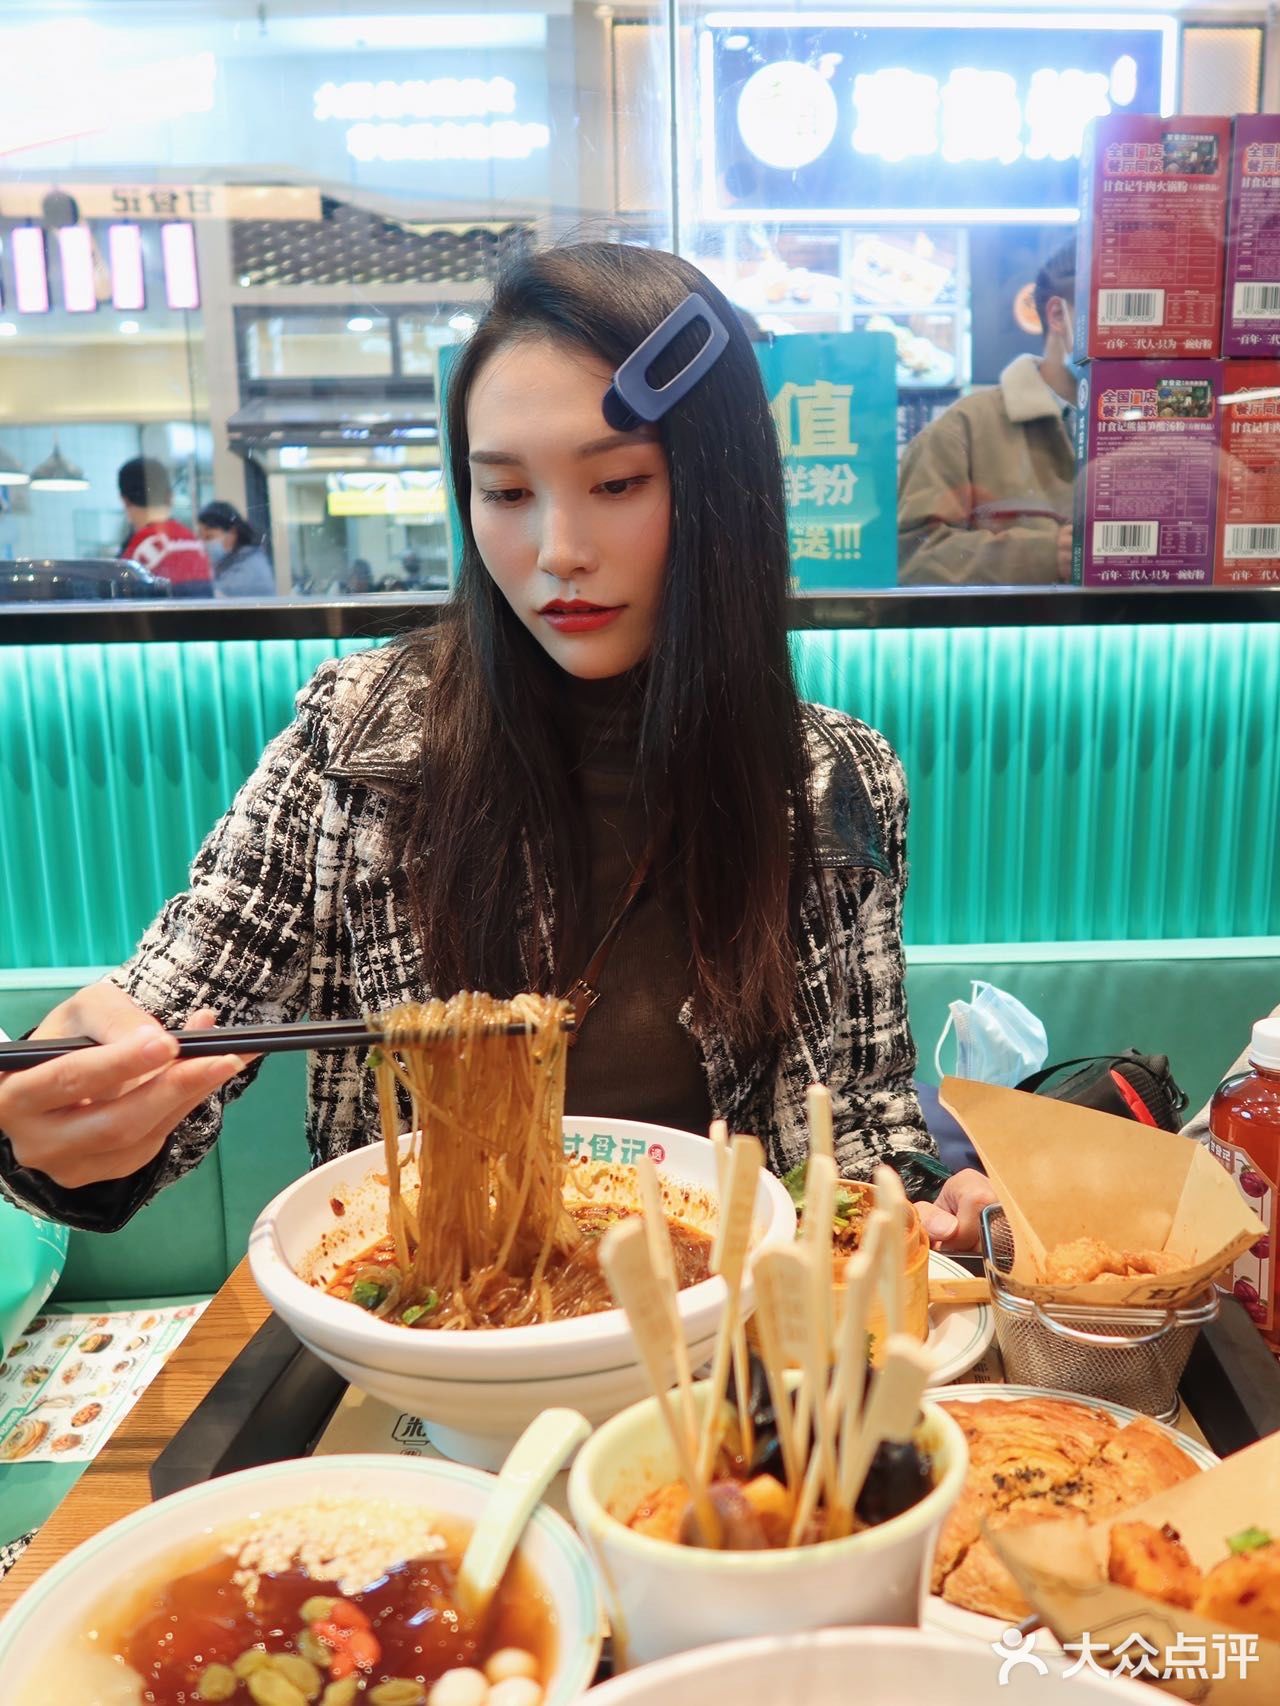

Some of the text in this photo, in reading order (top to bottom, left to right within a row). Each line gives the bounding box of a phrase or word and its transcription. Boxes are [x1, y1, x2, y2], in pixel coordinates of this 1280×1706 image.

[769, 380, 859, 456] 值
[1102, 388, 1157, 404] 全国门店
